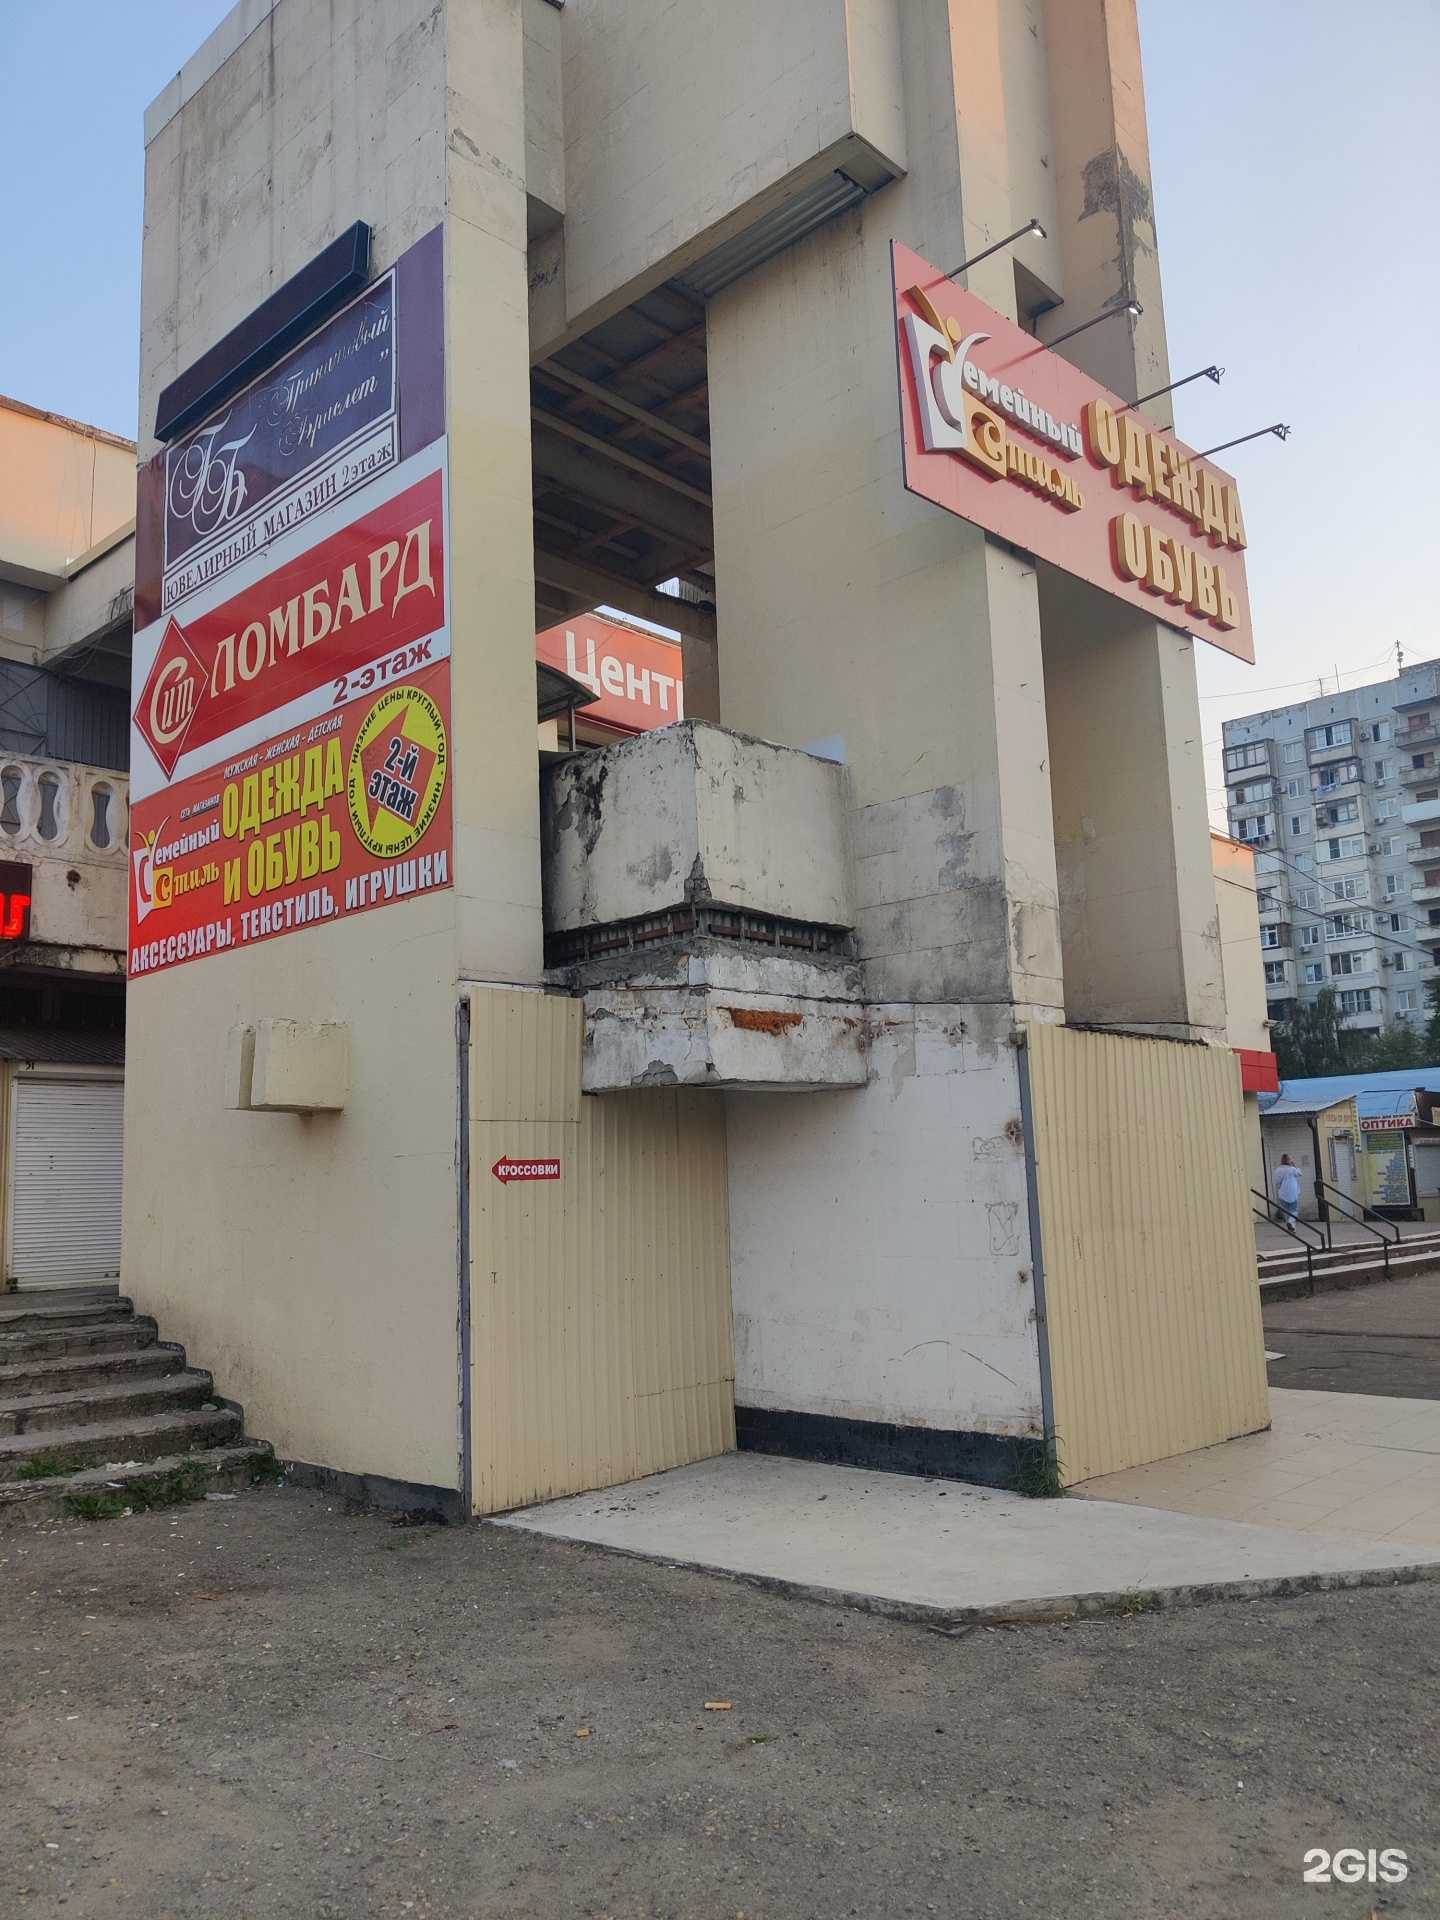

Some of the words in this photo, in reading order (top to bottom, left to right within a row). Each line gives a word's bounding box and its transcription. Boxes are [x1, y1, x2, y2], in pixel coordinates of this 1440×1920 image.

[904, 312, 1083, 460] Семейный
[963, 388, 1085, 513] Стиль
[1083, 398, 1248, 551] ОДЕЖДА
[166, 523, 257, 604] ЮВЕЛИРНЫЙ
[263, 472, 338, 542] МАГАЗИН
[1114, 511, 1241, 631] ОБУВЬ
[210, 519, 436, 699] ЛОМБАРД
[224, 753, 259, 779] МУЖСКАЯ
[264, 733, 301, 760] ЖЕНСКАЯ
[307, 714, 343, 743] ДЕТСКАЯ
[352, 713, 377, 764] НИЗКИЕ
[378, 690, 405, 712] ЦЕНЫ
[406, 689, 442, 729] КРУГЛЫЙ
[437, 732, 445, 764] ГОД
[223, 736, 345, 842] ОДЕЖДА
[415, 782, 442, 839] НИЗКИЕ
[133, 816, 220, 924] Семейный
[153, 861, 220, 908] Стиль
[224, 857, 241, 906] И
[247, 814, 341, 898] ОБУВЬ
[385, 835, 413, 854] ЦЕНЫ
[131, 918, 236, 974] АКСЕССУАРЫ,
[241, 886, 339, 942] ТЕКСТИЛЬ,
[345, 850, 448, 911] ИГРУШКИ
[498, 1164, 558, 1176] КРОССОВКИ
[1361, 1118, 1414, 1130] ОПТИКА
